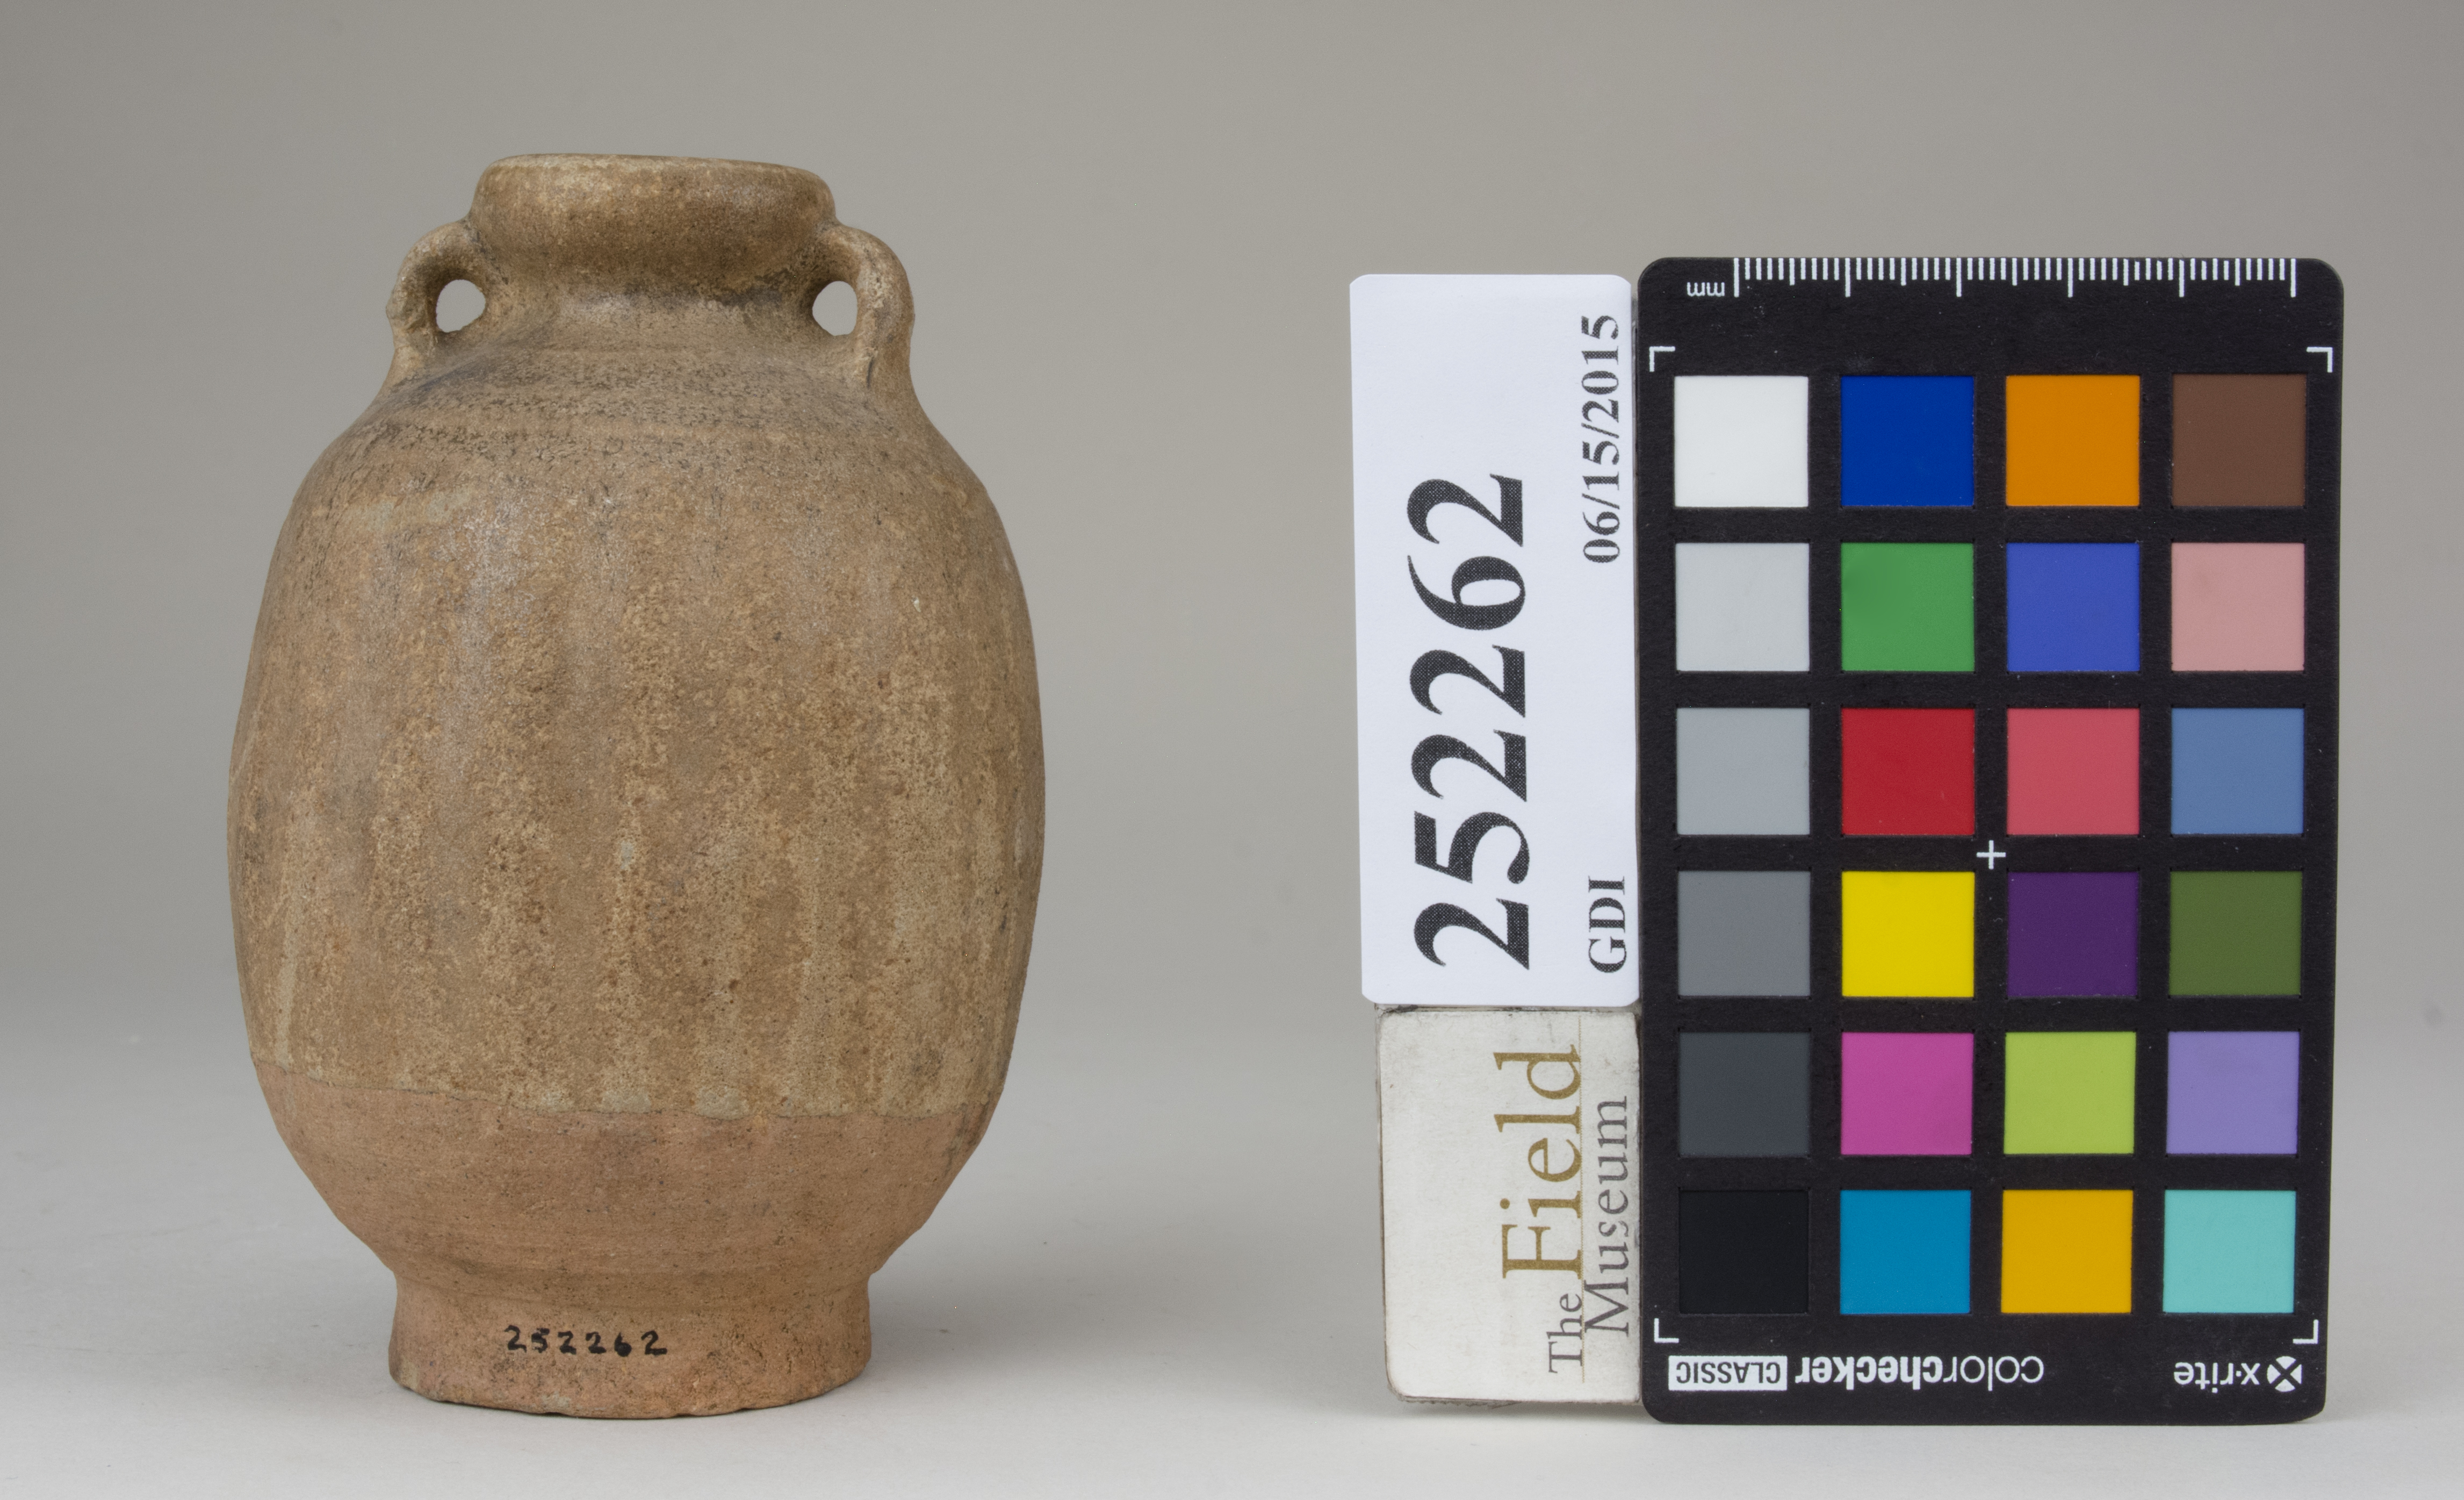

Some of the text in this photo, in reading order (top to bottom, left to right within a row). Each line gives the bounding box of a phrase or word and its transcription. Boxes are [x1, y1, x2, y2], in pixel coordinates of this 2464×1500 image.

[1687, 282, 1726, 298] mm
[1581, 315, 1621, 563] 06/15/2015
[1407, 474, 1530, 971] 252262
[1588, 877, 1627, 973] GDI
[1493, 1044, 1583, 1374] The Field
[1583, 1095, 1630, 1337] Museum
[505, 1325, 668, 1358] 252262
[1676, 1356, 2045, 1392] colorchecker CLASSIC
